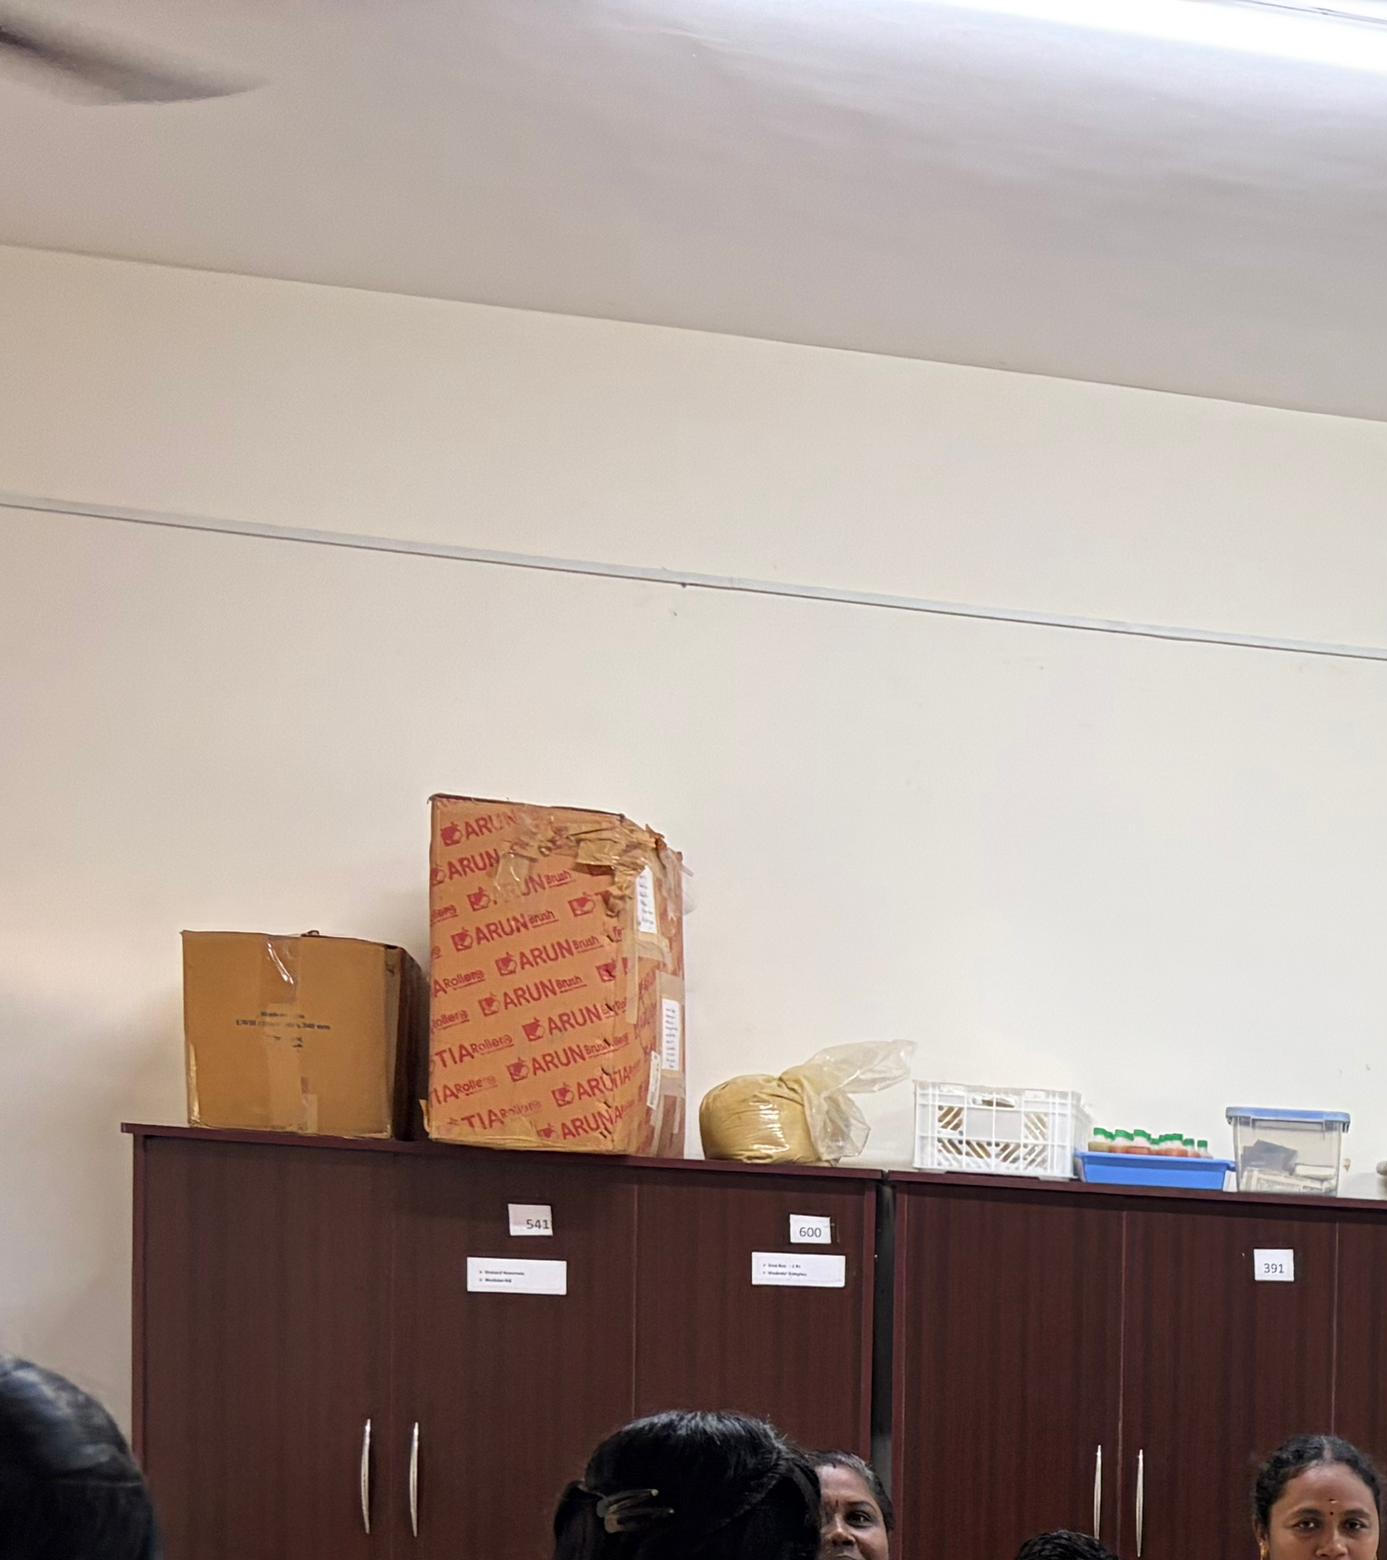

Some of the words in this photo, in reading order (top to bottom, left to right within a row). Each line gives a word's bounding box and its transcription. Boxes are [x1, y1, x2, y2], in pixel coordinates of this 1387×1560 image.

[447, 848, 500, 880] ARUN
[475, 914, 529, 945] ARUN
[519, 939, 574, 970] ARUN
[572, 935, 600, 950] Brush
[503, 979, 557, 1010] ARUN
[556, 975, 583, 990] Brush
[548, 1004, 602, 1036] ARUN
[531, 1044, 586, 1075] ARUN
[526, 1218, 550, 1231] 541
[799, 1226, 822, 1239] 600
[1263, 1262, 1285, 1274] 391
